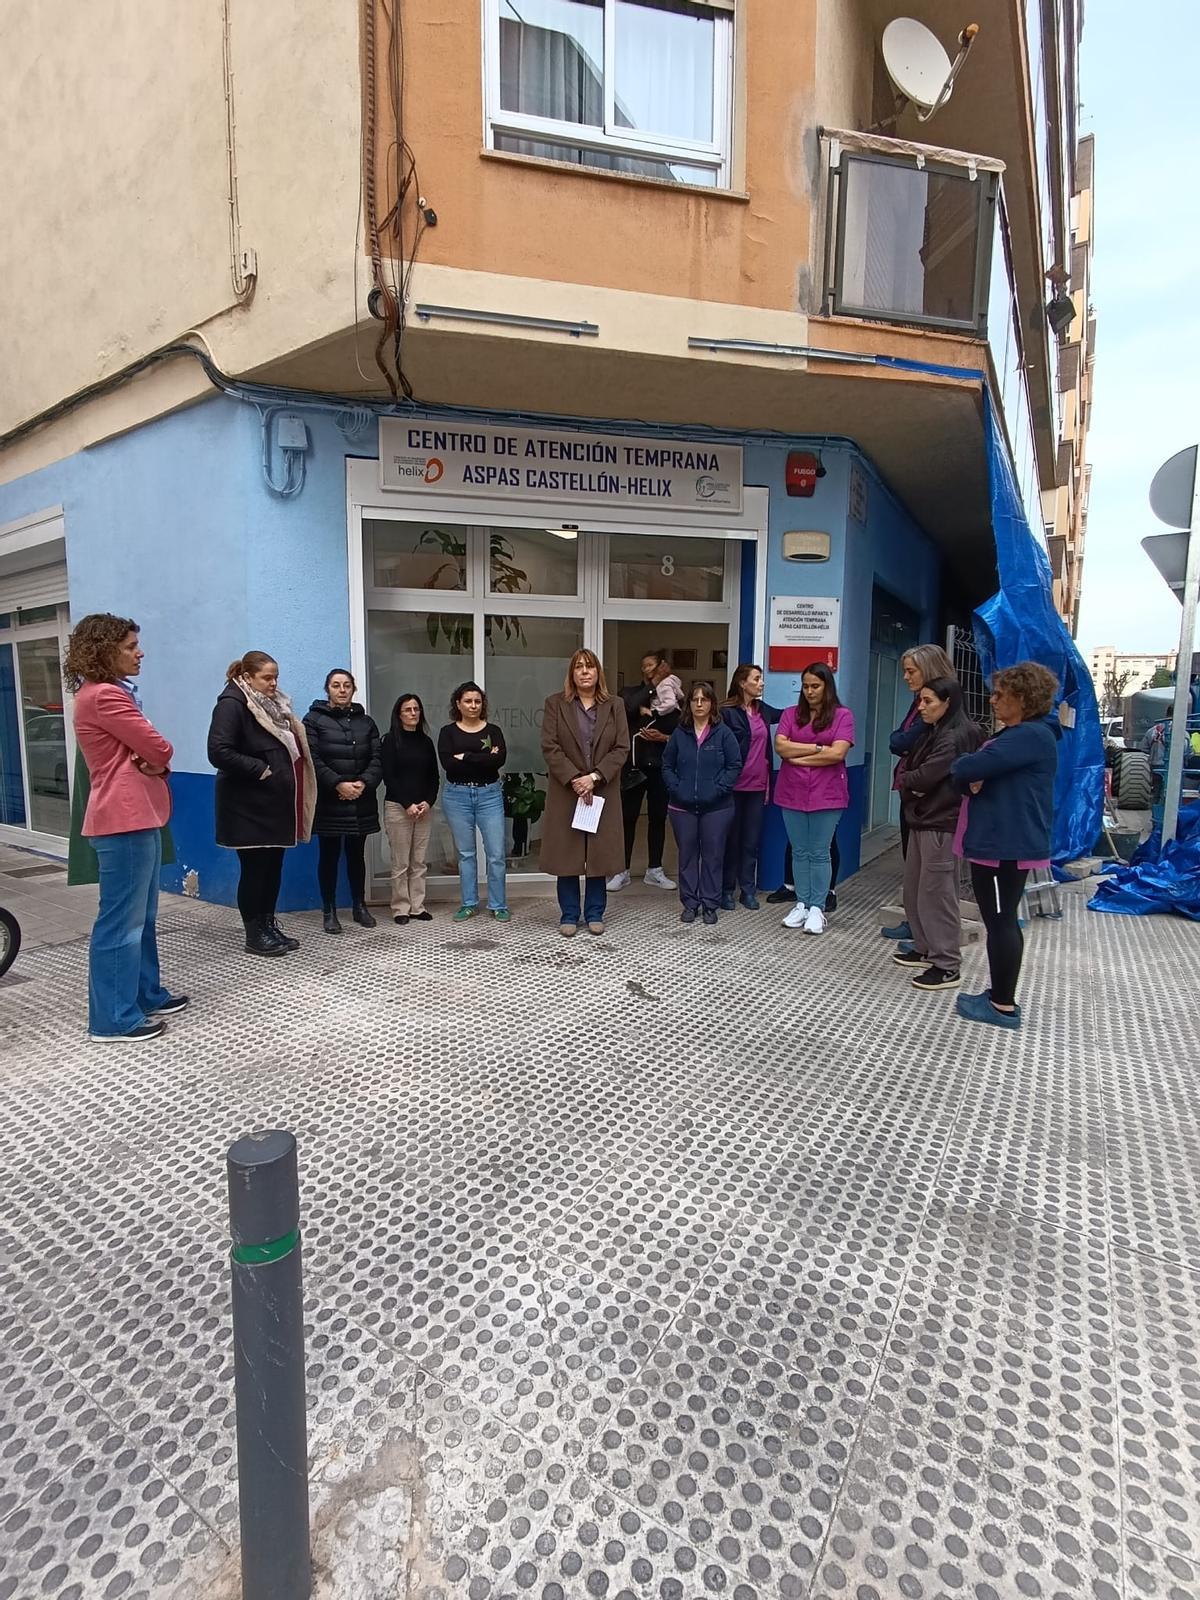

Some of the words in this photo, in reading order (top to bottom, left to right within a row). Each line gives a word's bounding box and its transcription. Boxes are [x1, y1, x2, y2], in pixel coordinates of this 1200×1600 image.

[407, 429, 487, 454] CENTRO
[494, 436, 517, 457] DE
[524, 438, 620, 465] ATENCIÓN
[624, 447, 720, 472] TEMPRANA
[398, 465, 424, 477] helix
[462, 464, 520, 487] ASPAS
[526, 469, 673, 498] CASTELLÓN-HELIX
[661, 555, 675, 576] 8
